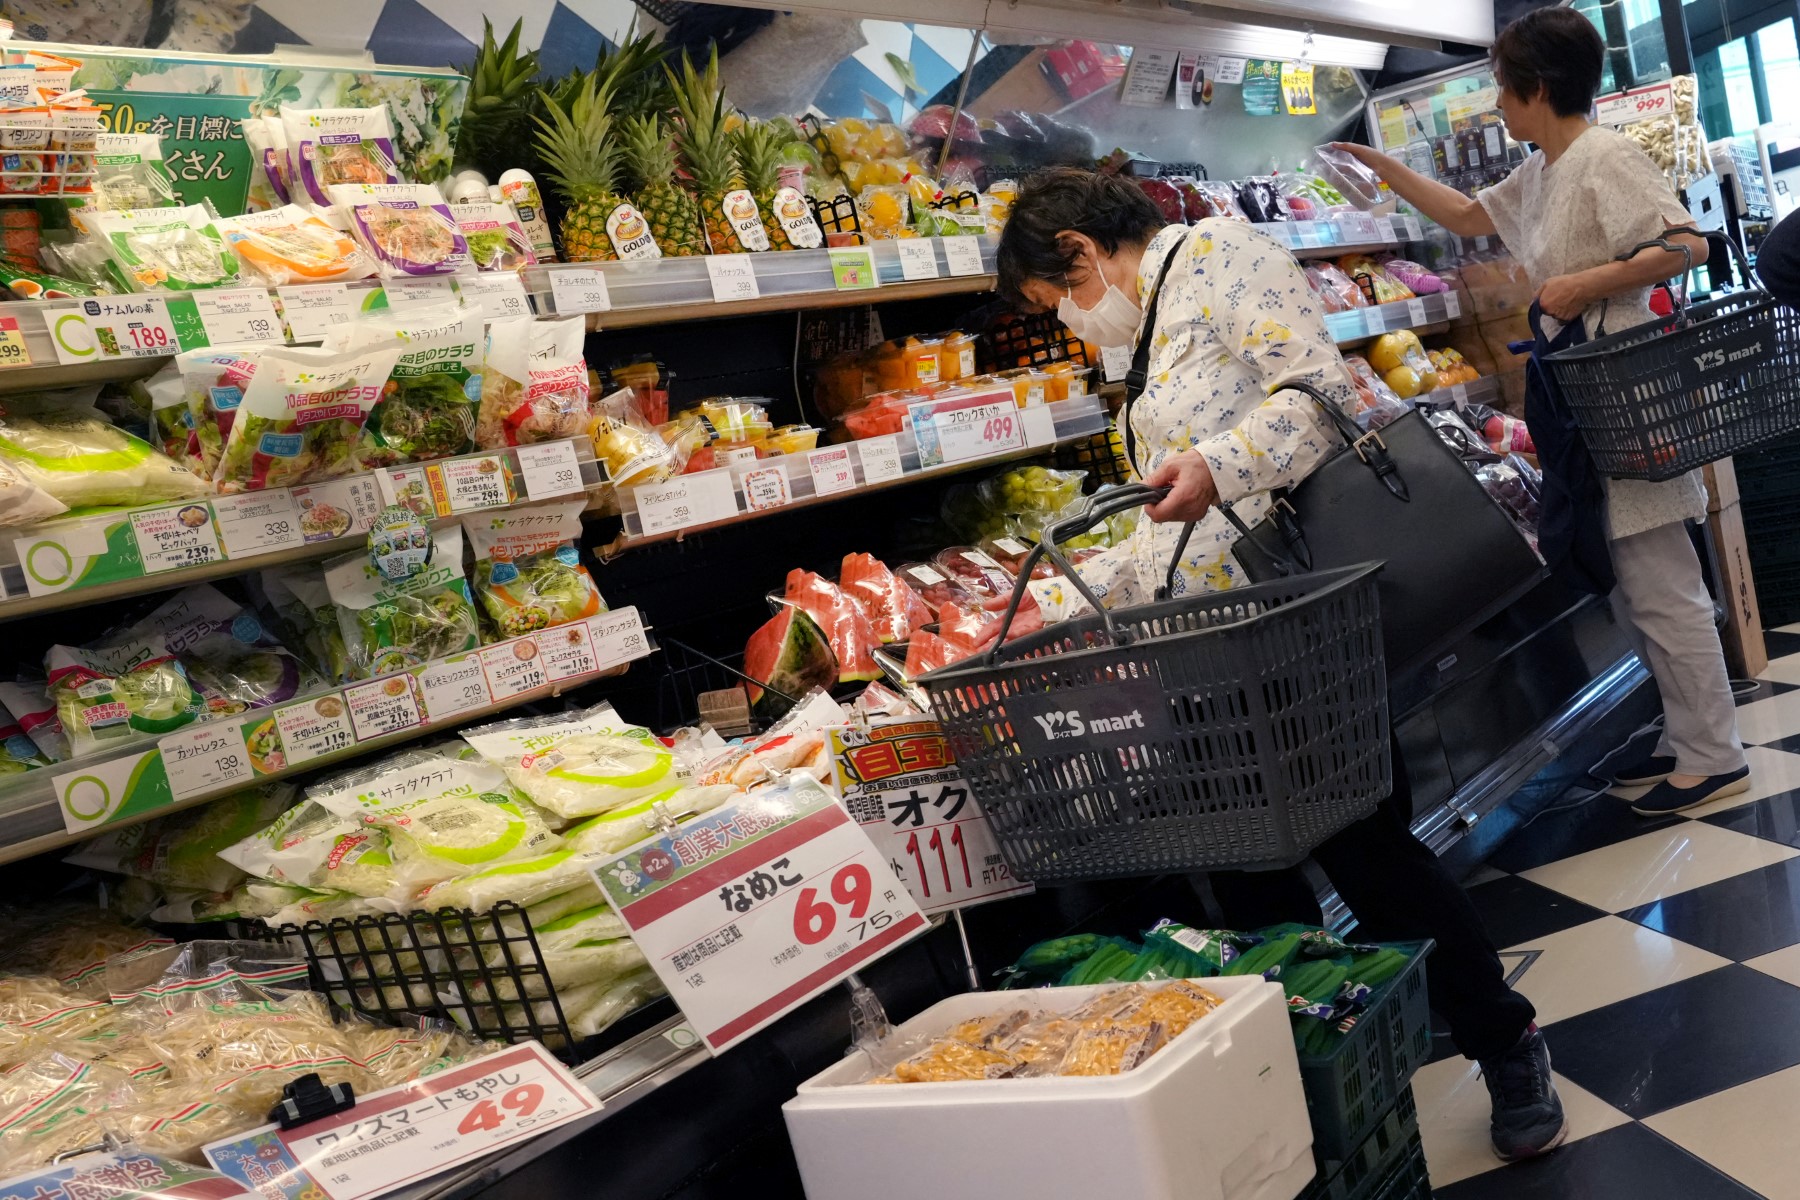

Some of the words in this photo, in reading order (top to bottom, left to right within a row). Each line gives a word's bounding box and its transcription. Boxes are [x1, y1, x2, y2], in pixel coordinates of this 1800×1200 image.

[1636, 97, 1665, 112] 999
[321, 115, 366, 125] サラダクラブ
[740, 218, 758, 231] GOLD
[789, 217, 808, 230] GOLD
[623, 237, 646, 254] GOLD
[557, 278, 597, 286] チョレギのたれ
[502, 297, 520, 308] 139
[584, 292, 600, 303] 399
[103, 303, 154, 316] ナムルの素
[248, 319, 270, 332] 139
[129, 326, 167, 349] 189
[398, 342, 476, 364] 品目のサラダ
[1728, 341, 1762, 362] mart
[284, 386, 380, 410] 10品目のサラダ
[948, 404, 1000, 423] ブロックすいか
[983, 416, 1013, 442] 499
[554, 469, 573, 483] 339
[835, 472, 848, 482] 339
[481, 491, 499, 501] 299
[672, 505, 689, 518] 359
[264, 520, 289, 536] 339
[508, 513, 564, 527] サラダクラブ
[153, 528, 199, 541] 千切りキャベツ
[274, 534, 289, 542] 367
[185, 545, 209, 560] 239
[488, 539, 569, 558] イタリアンサラ
[593, 617, 637, 638] イタリアンサラダ
[622, 633, 640, 648] 239
[495, 661, 533, 679] ミックスサラダ
[572, 656, 589, 669] 119
[522, 671, 540, 685] 119
[462, 683, 481, 698] 219
[389, 710, 409, 724] 219
[1089, 709, 1145, 734] mart
[292, 720, 340, 741] 千切りキャベツ
[1053, 730, 1072, 739] ワイズ
[324, 731, 346, 747] 119
[177, 738, 228, 760] カットレタス
[214, 755, 238, 772] 139
[223, 769, 240, 779] 151
[381, 766, 454, 799] サラダクラブ
[905, 823, 972, 898] 111
[718, 857, 804, 914] なめこ
[793, 863, 873, 946] 69
[884, 889, 896, 904] 円
[846, 909, 893, 942] 75
[671, 924, 744, 973] 産地は商品に記載
[684, 972, 707, 990] 1袋
[315, 1072, 521, 1147] ワイズマートもやし
[456, 1083, 545, 1136] 49
[515, 1108, 558, 1129] 53
[321, 1126, 422, 1169] 産地は商品に記載
[331, 1174, 352, 1186] 1袋
